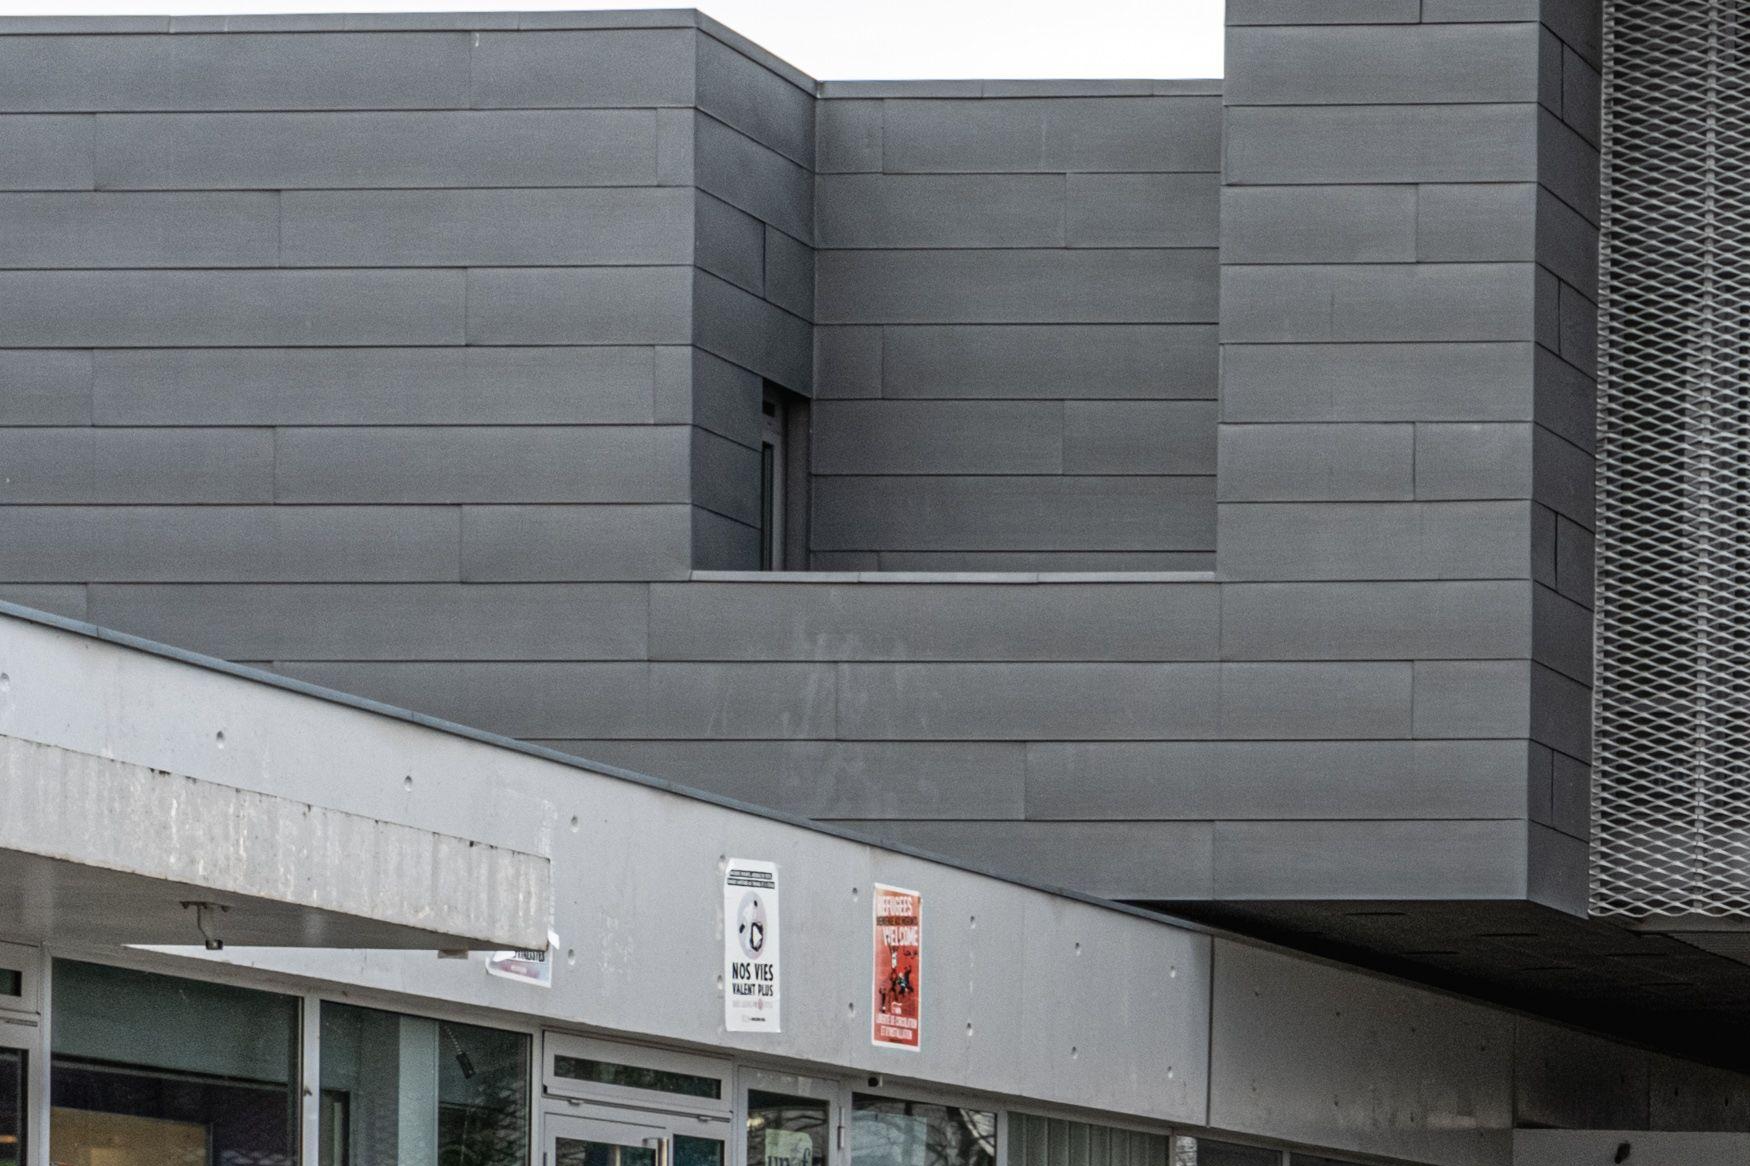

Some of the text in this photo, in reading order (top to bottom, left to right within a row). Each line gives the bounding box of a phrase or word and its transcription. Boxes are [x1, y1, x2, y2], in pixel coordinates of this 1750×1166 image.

[882, 926, 918, 946] WELCOME
[732, 962, 774, 981] NOS VIES
[732, 983, 773, 997] VALENT PLUS
